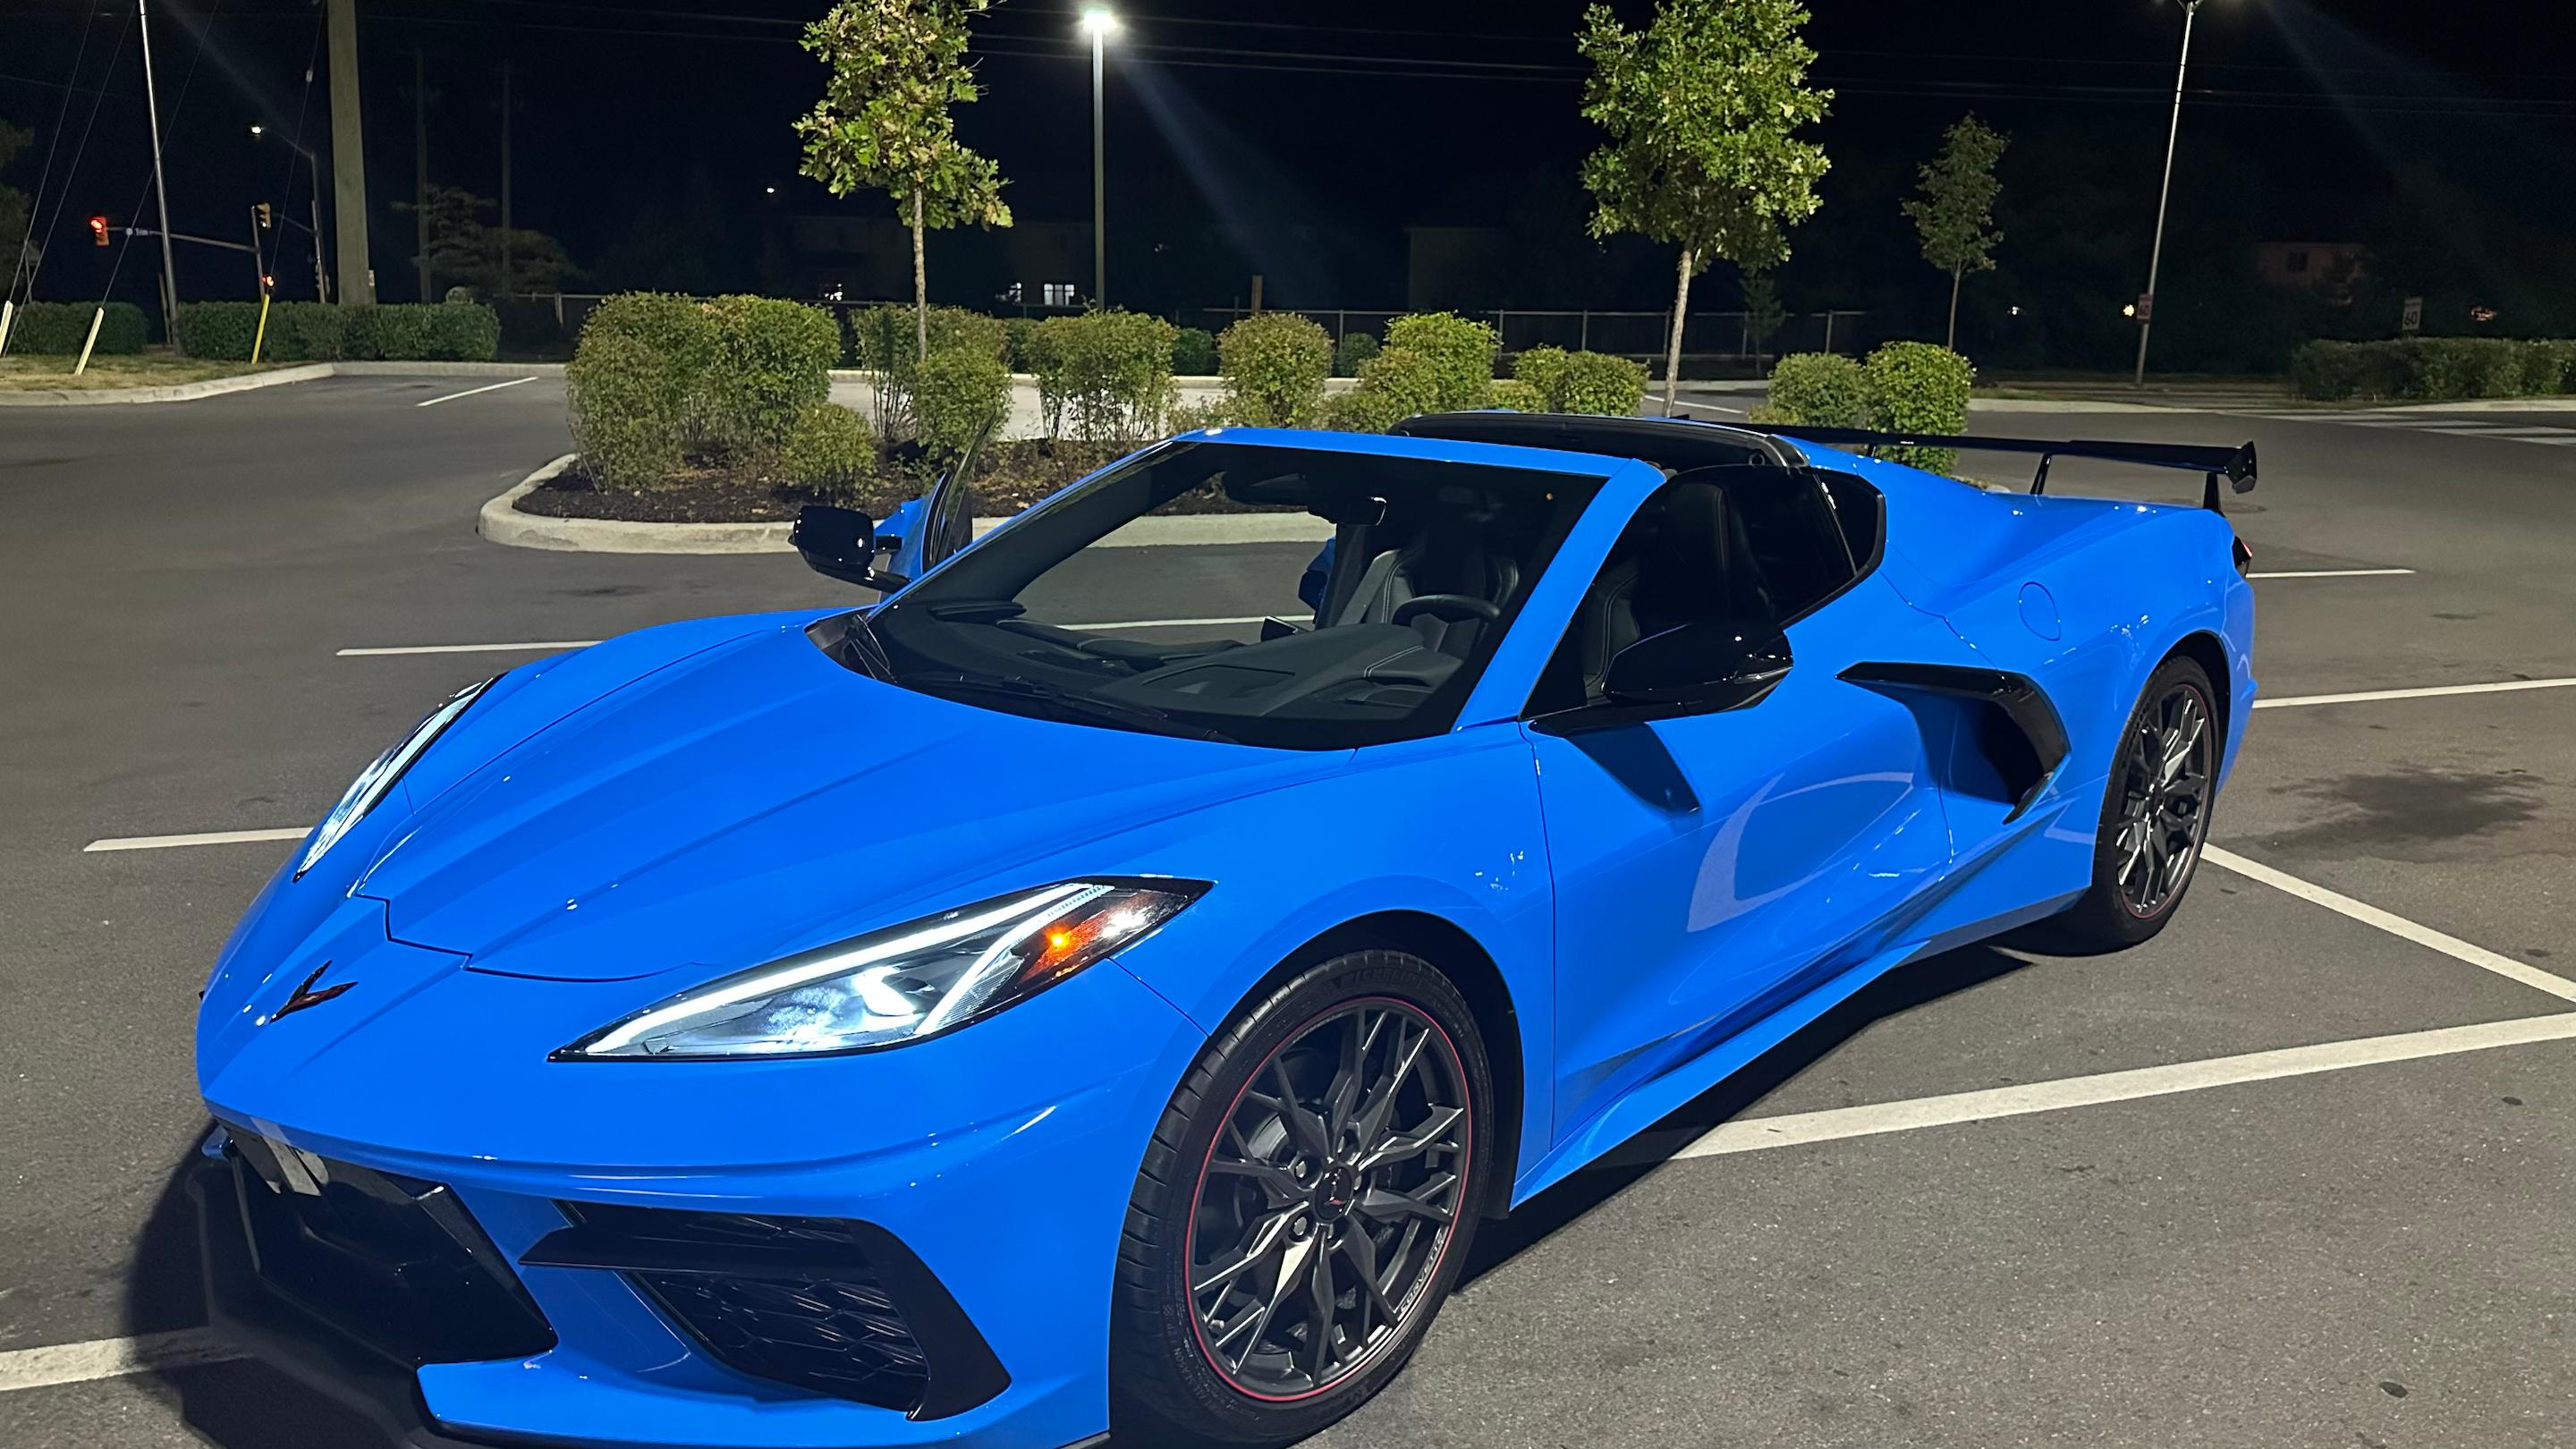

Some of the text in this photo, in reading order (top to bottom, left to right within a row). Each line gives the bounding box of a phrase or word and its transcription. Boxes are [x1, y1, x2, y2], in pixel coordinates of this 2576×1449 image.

[2404, 311, 2419, 326] 60
[1400, 1233, 1444, 1313] CORVETTE
[1174, 1347, 1196, 1385] SEASON
